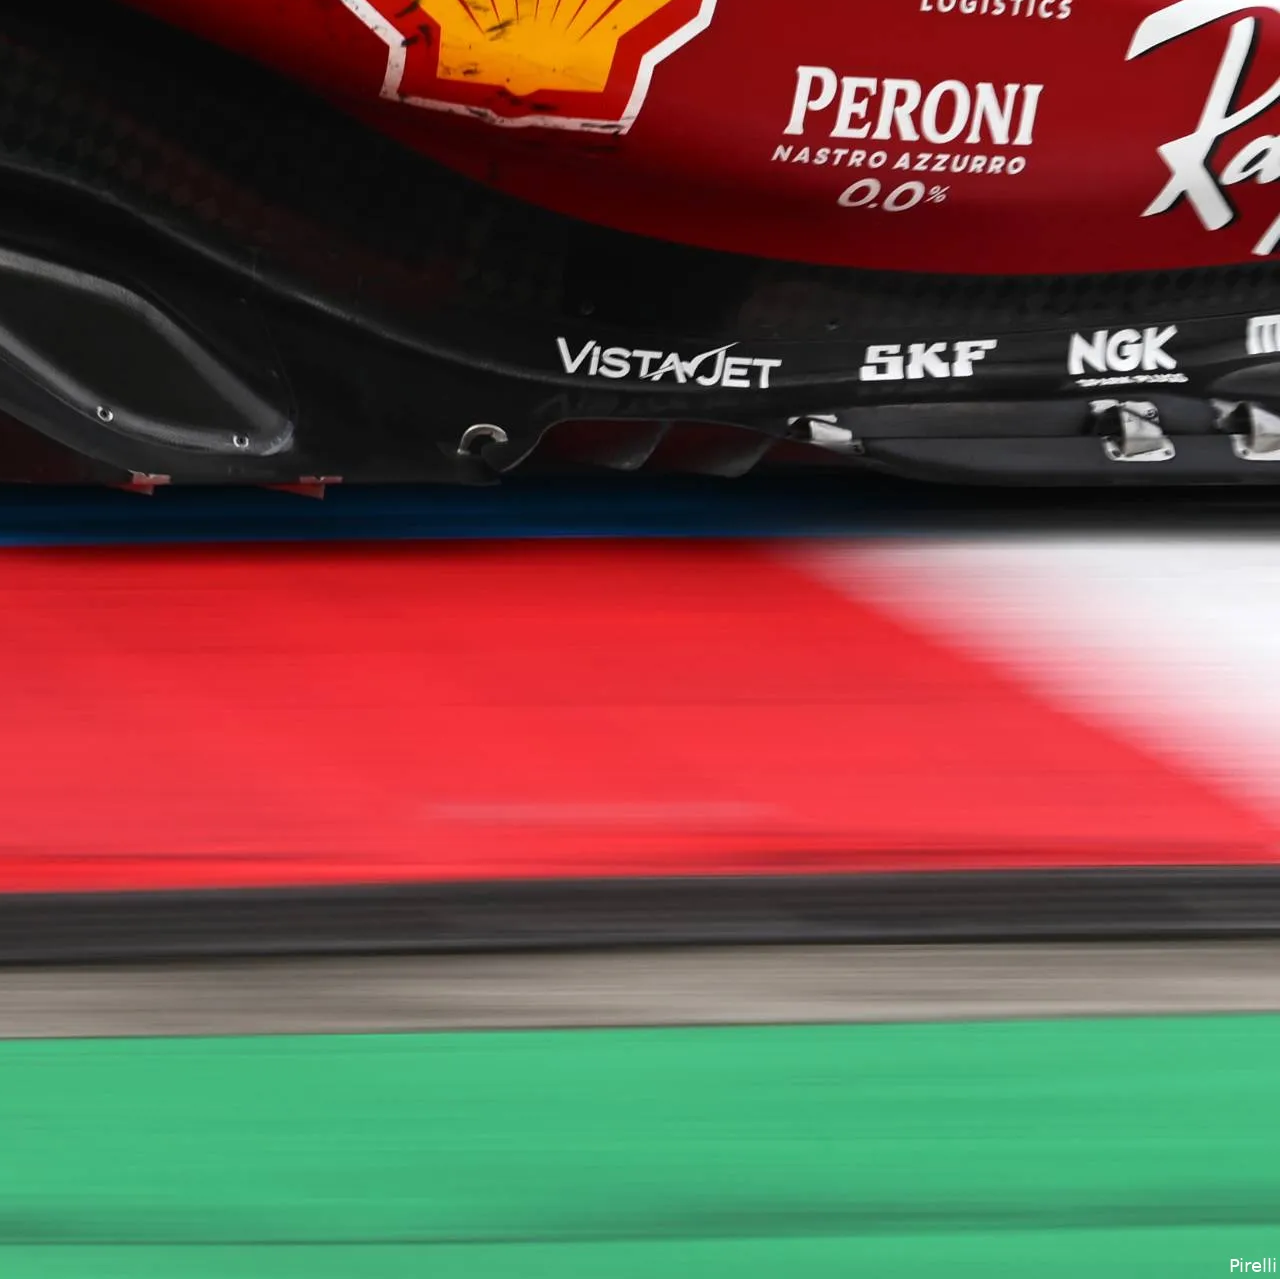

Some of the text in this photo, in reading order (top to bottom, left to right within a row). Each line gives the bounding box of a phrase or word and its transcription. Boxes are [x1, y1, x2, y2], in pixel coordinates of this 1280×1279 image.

[782, 65, 1044, 146] PERONI
[771, 144, 1026, 175] NASTRO AZZURRO
[837, 178, 951, 212] 0.0%
[858, 339, 998, 382] SKF
[1067, 324, 1178, 376] NGK
